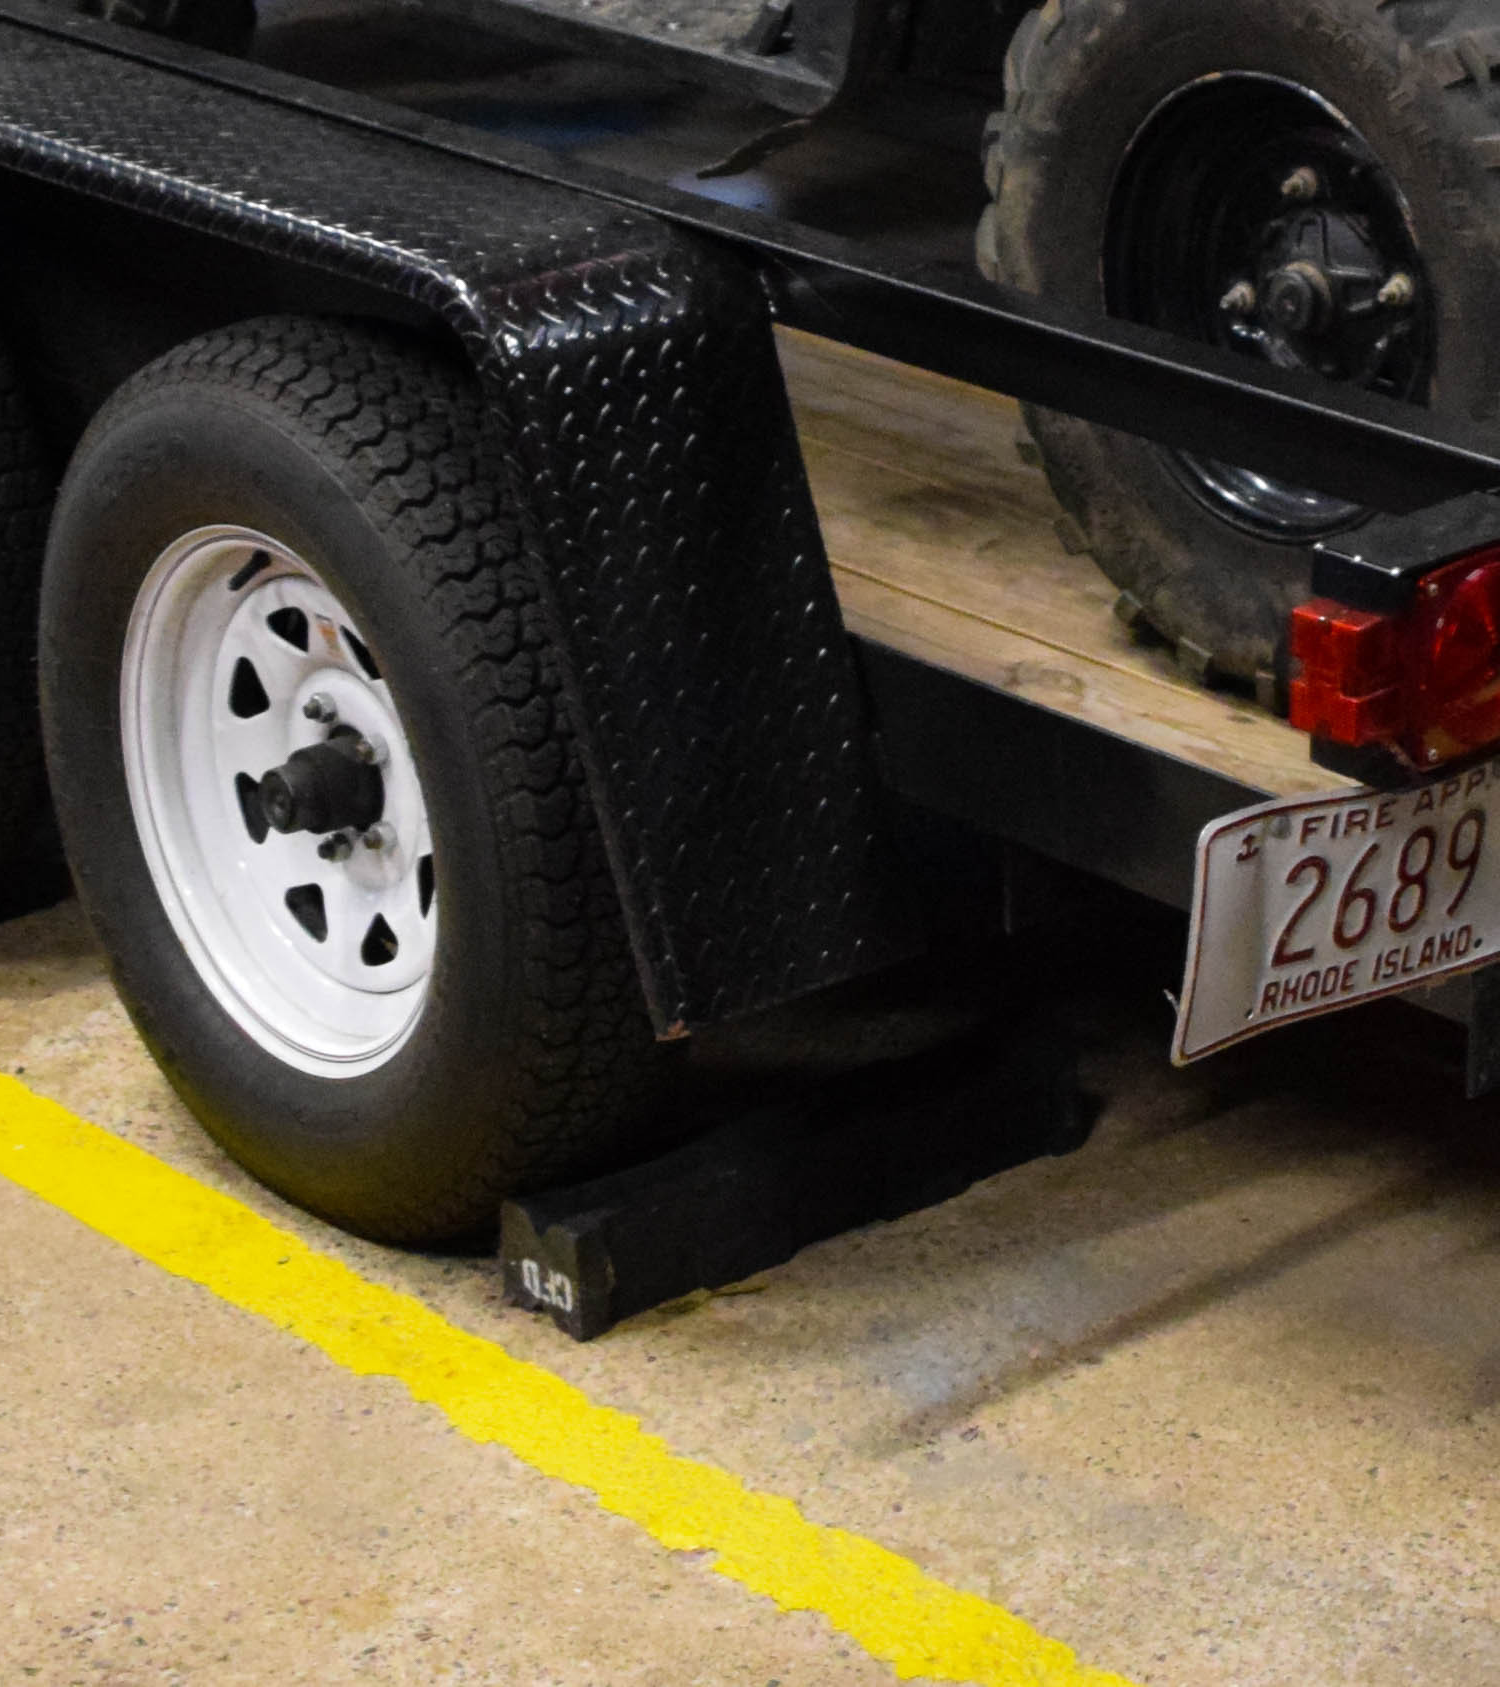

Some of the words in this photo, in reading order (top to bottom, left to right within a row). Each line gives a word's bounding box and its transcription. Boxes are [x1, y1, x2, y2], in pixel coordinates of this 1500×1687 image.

[1299, 798, 1397, 846] FIRE
[1270, 808, 1486, 968] 2689
[1259, 959, 1359, 1014] RHODE
[1371, 923, 1474, 983] ISLAND
